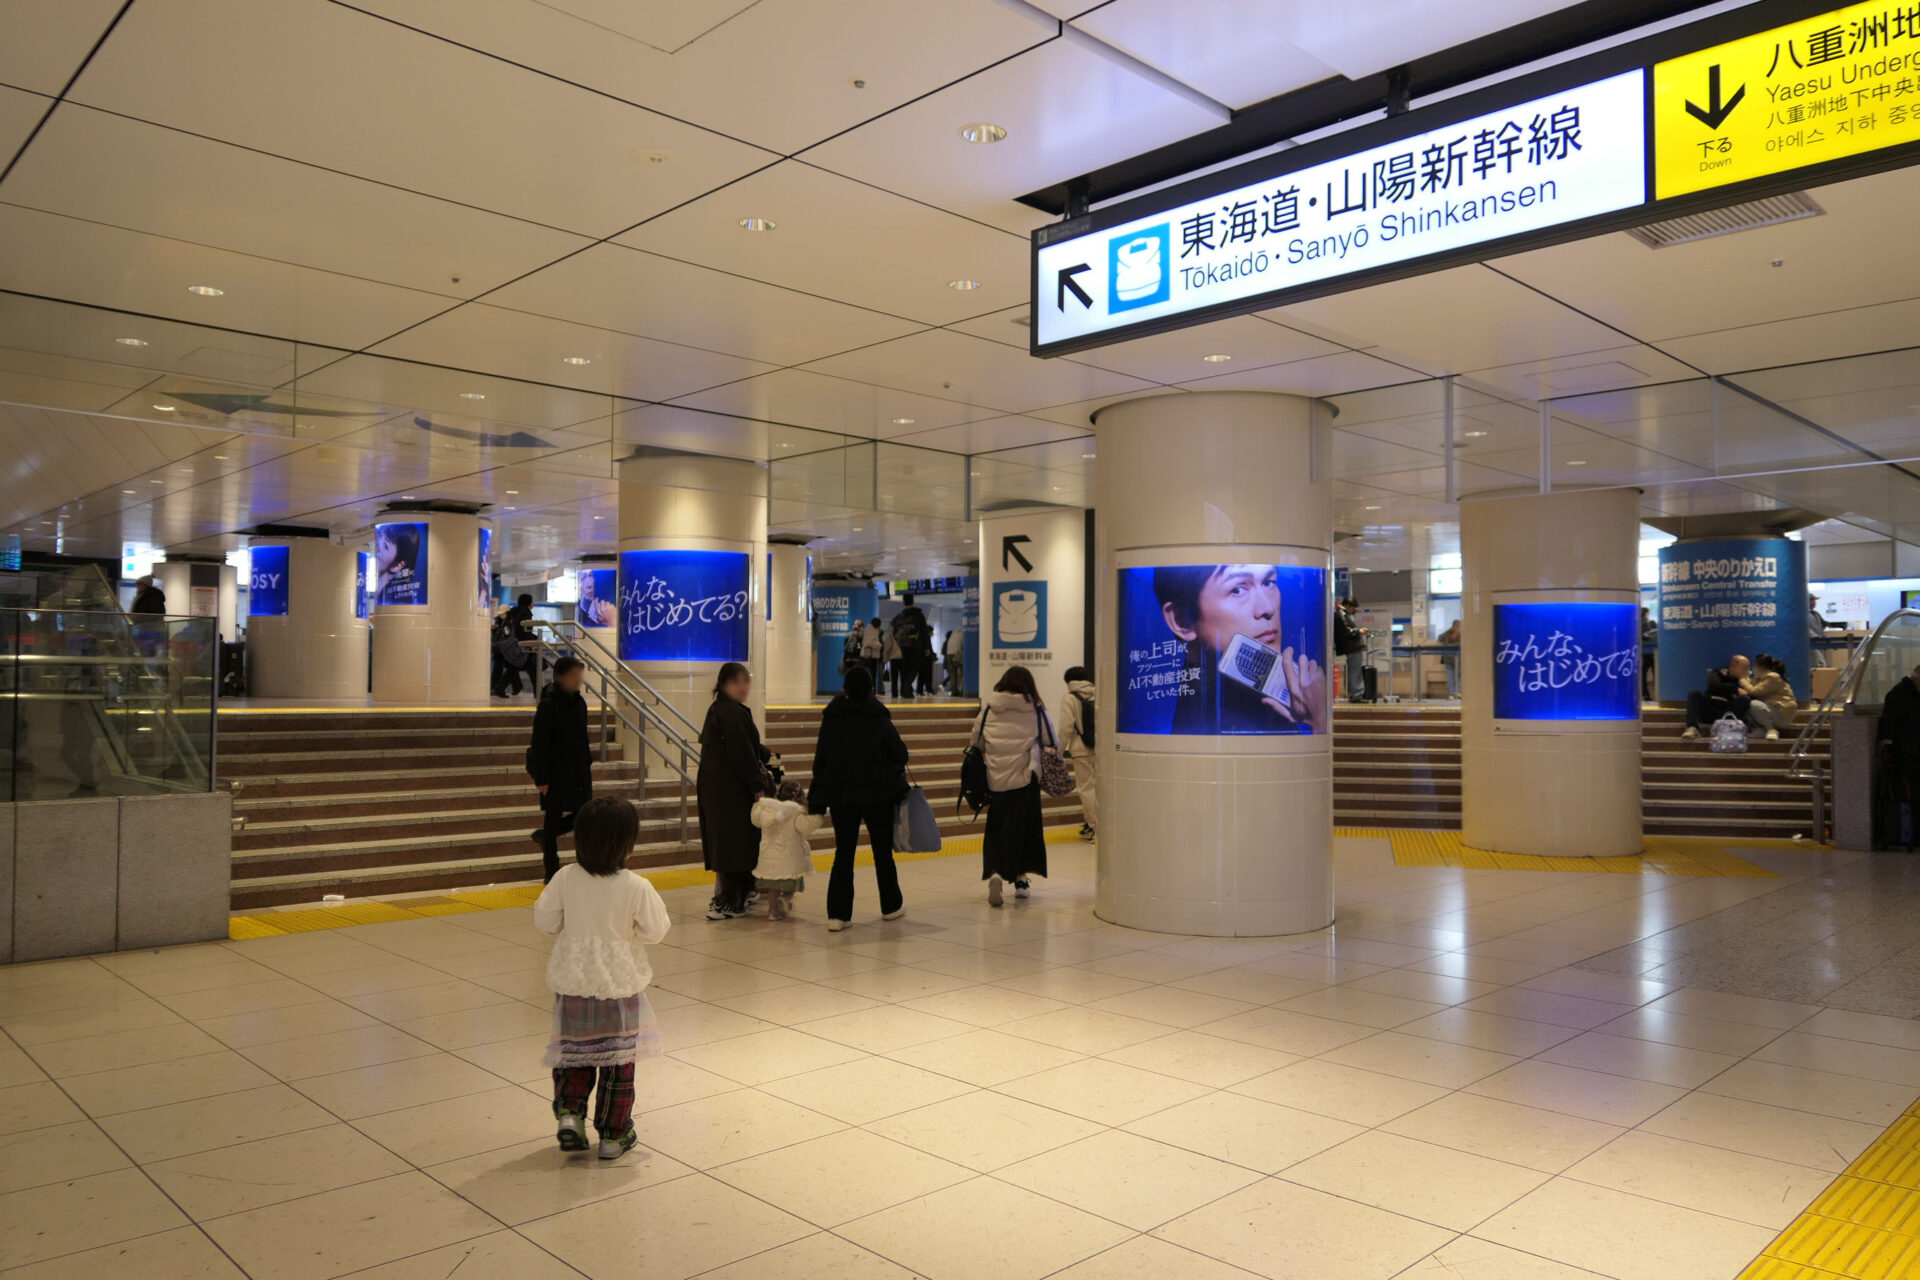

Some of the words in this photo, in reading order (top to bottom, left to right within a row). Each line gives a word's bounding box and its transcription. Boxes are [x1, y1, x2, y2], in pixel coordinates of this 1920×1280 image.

[1766, 75, 1832, 104] Yaesu
[1766, 75, 1920, 129] 八重洲地下中央
[1697, 136, 1732, 158] 下る
[1765, 129, 1825, 153] 야에스
[1836, 112, 1877, 136] 지하
[1699, 156, 1732, 172] Down
[1180, 104, 1583, 259] 東海道・山陽新幹線
[1380, 179, 1557, 242] Shinkansen
[1693, 556, 1777, 580] 中央のりかえ口
[619, 576, 676, 608] みんな、
[1701, 580, 1737, 590] Central
[1738, 578, 1777, 589] Transfer
[628, 590, 748, 636] はじめてる?
[1721, 618, 1776, 628] Shinkansen
[1496, 630, 1582, 665] みんな、
[1128, 667, 1201, 690] AI不動産投資
[1146, 684, 1196, 700] していた件。
